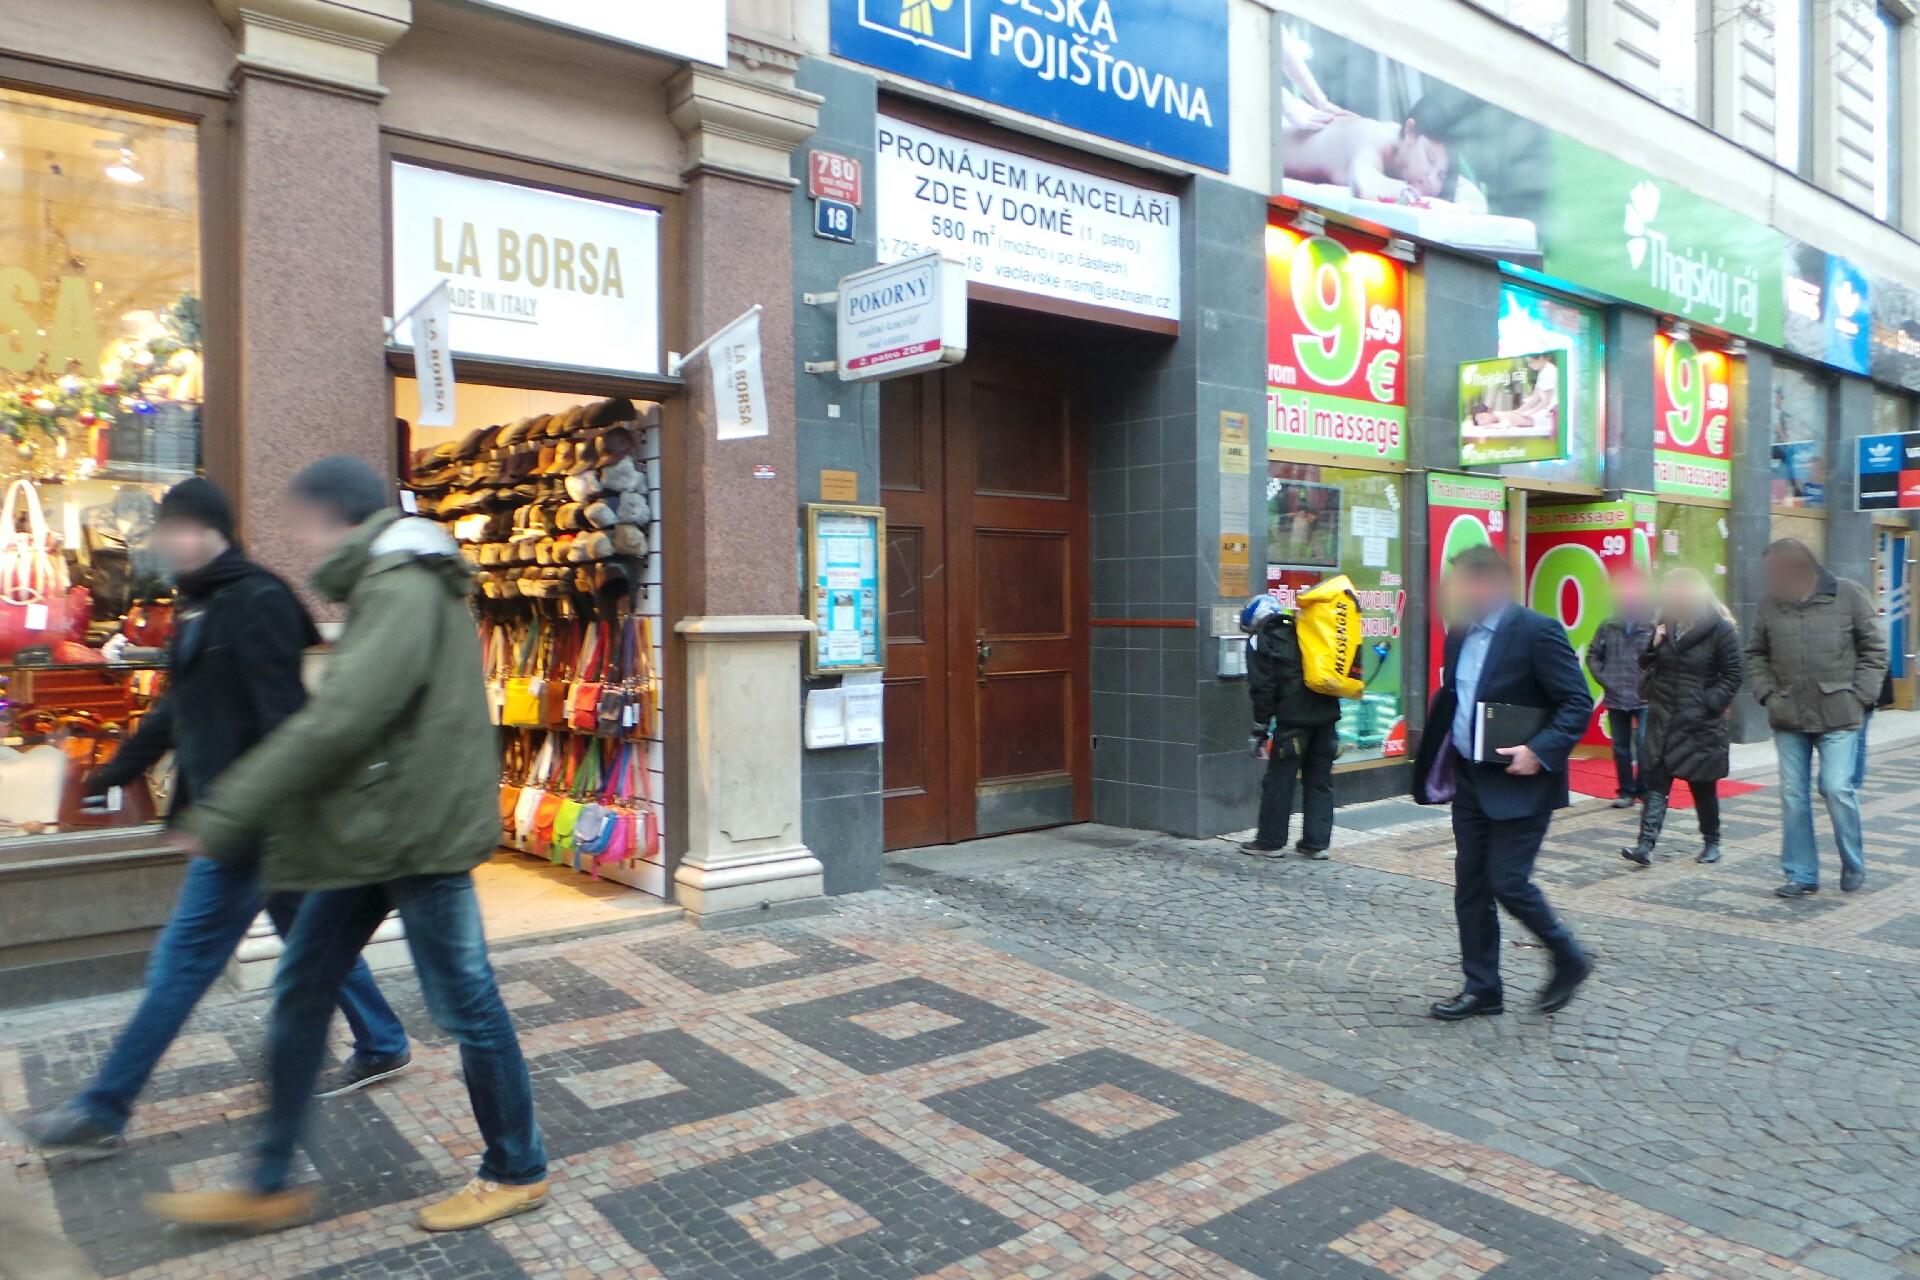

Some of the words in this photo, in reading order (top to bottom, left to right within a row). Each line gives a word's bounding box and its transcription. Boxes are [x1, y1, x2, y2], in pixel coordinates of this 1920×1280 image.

[989, 13, 1213, 127] POJIŠŤOVNA
[817, 155, 855, 181] 780
[878, 129, 1028, 191] PRONÁJEM
[1036, 172, 1171, 227] KANCELÁŘÍ
[827, 207, 848, 231] 18
[915, 175, 967, 210] ZDE
[977, 191, 993, 216] V
[1003, 197, 1073, 236] DOMĚ
[932, 215, 965, 241] 580
[433, 216, 482, 278] LA
[498, 227, 624, 299] BORSA
[450, 287, 476, 309] ADE
[481, 291, 496, 311] IN
[502, 294, 538, 317] ITALY
[735, 369, 753, 426] BORSA
[1268, 363, 1297, 385] rom
[1267, 391, 1309, 436] Thai
[1313, 409, 1401, 454] massage
[1555, 509, 1626, 525] massage
[1334, 601, 1348, 676] MESSENGER
